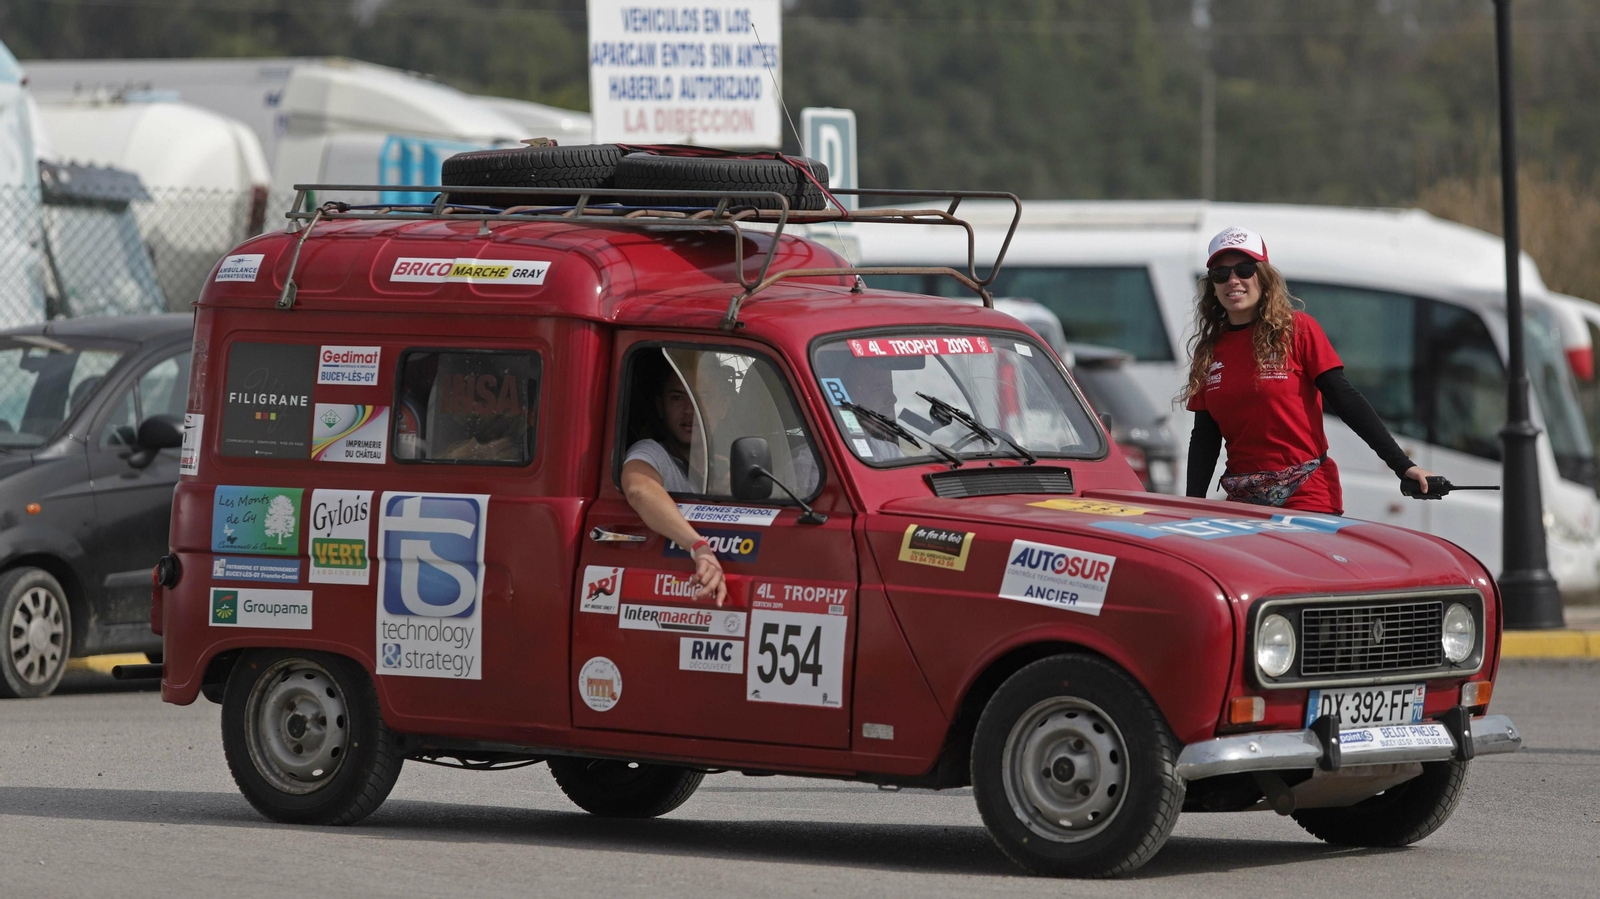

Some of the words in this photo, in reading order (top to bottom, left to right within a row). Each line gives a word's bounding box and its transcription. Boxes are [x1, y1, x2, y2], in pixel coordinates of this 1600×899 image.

[621, 7, 699, 32] VEHICULOS
[703, 8, 721, 32] EN
[725, 8, 750, 32] LOS
[711, 43, 732, 67] SIN
[736, 43, 777, 67] ANTES
[609, 75, 674, 100] HABERLO
[679, 75, 762, 100] AUTORIZADO
[624, 107, 648, 132] LA
[654, 107, 755, 132] DIRECCION
[512, 268, 545, 278] GRAY
[868, 340, 887, 355] 4L
[888, 339, 939, 355] TROPHY
[943, 338, 974, 354] 2019
[322, 350, 378, 364] Gedimat
[229, 392, 308, 407] FILIGRANE
[825, 381, 846, 402] B
[345, 440, 381, 449] IMPRIMERIE
[345, 450, 354, 458] DU
[355, 449, 382, 459] CHÂTEAU
[219, 495, 234, 508] Les
[237, 494, 269, 507] Monts
[226, 513, 239, 524] de
[242, 511, 257, 524] Gy
[313, 495, 368, 537] Gylois
[694, 504, 732, 514] RENNES
[732, 507, 773, 516] SCHOOL
[694, 513, 740, 522] BUSINESS
[315, 542, 364, 566] VERT
[311, 569, 368, 577] JARDINERIE
[1011, 547, 1110, 582] AUTOSUR
[1037, 574, 1068, 585] TECHNIQUE
[1069, 581, 1105, 592] AUTOMOBILE
[756, 583, 775, 599] 4L
[784, 585, 848, 604] TROPHY
[1024, 585, 1079, 606] ANCIER
[243, 600, 308, 617] Groupama
[624, 605, 713, 628] Intermarché
[382, 617, 475, 649] technology
[691, 640, 734, 662] RMC
[757, 622, 823, 687] 554
[383, 643, 401, 668] &
[405, 650, 475, 677] strategy
[689, 661, 732, 671] DÉCOUVERTE
[1413, 705, 1423, 721] 70
[1340, 732, 1362, 743] point
[1409, 726, 1440, 737] PNEUS
